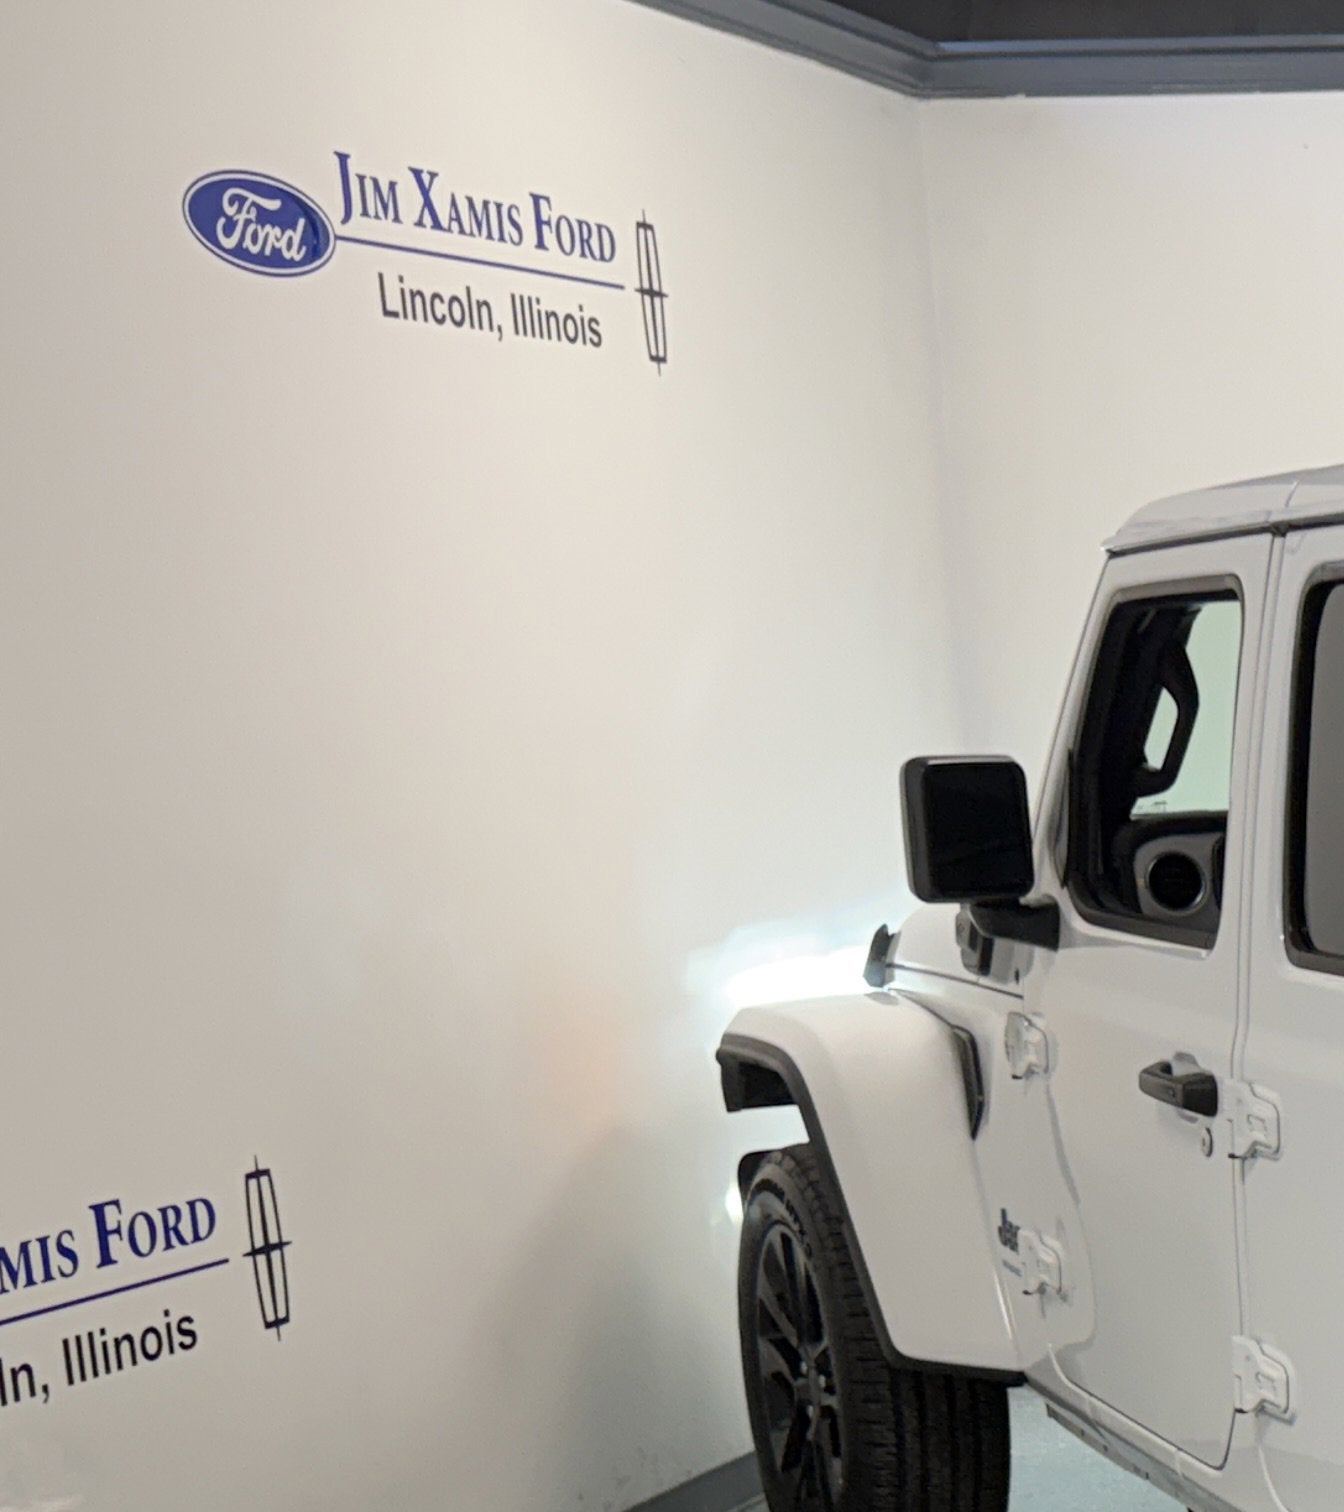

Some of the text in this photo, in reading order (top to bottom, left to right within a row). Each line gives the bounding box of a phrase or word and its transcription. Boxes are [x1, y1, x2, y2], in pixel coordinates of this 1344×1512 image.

[216, 187, 307, 262] Ford
[408, 166, 523, 247] XAMIS
[528, 192, 616, 263] FORD
[378, 272, 601, 348] Lincoln, Illinois
[0, 1198, 216, 1294] MIS FORD
[62, 1309, 198, 1386] Illinois
